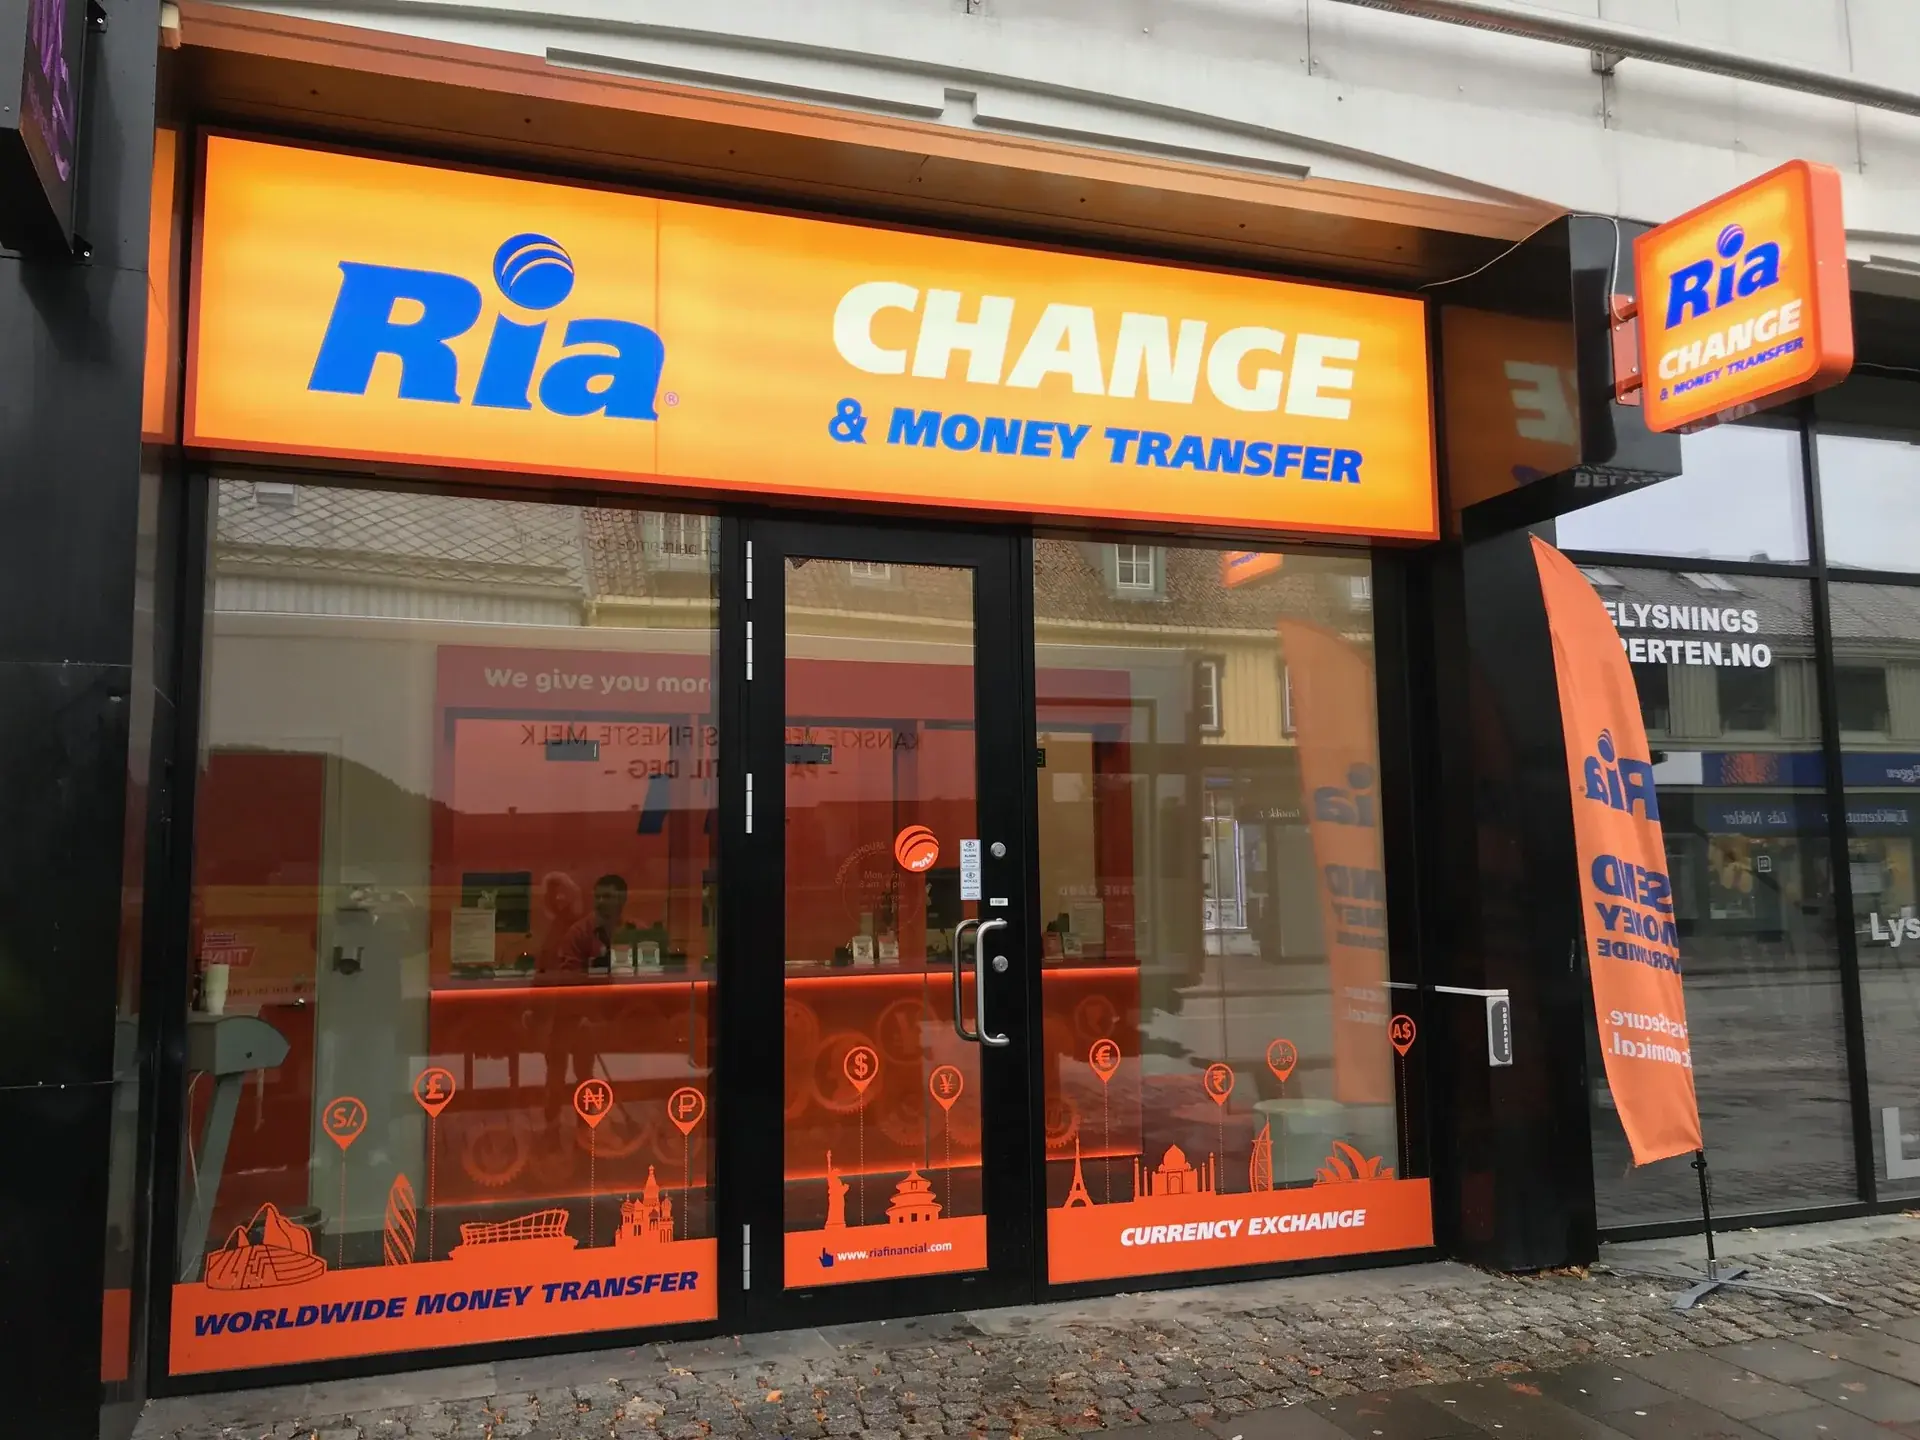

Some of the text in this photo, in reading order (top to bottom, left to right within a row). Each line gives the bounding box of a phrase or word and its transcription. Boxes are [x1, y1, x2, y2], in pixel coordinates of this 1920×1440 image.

[1665, 224, 1780, 331] Ria
[308, 234, 665, 421] Ria
[833, 281, 1361, 421] CHANGE
[1658, 299, 1803, 380] CHANGE
[1659, 336, 1804, 401] & MONEY TRANSFER
[829, 397, 1363, 484] & MONEY TRANSFER
[484, 667, 712, 695] We give you mor
[911, 851, 934, 869] PULL
[837, 1241, 953, 1262] www.riafinancial.com
[1120, 1209, 1367, 1247] CURRENCY EXCHANGE
[194, 1270, 699, 1337] WORLDWIDE MONEY TRANSFER
